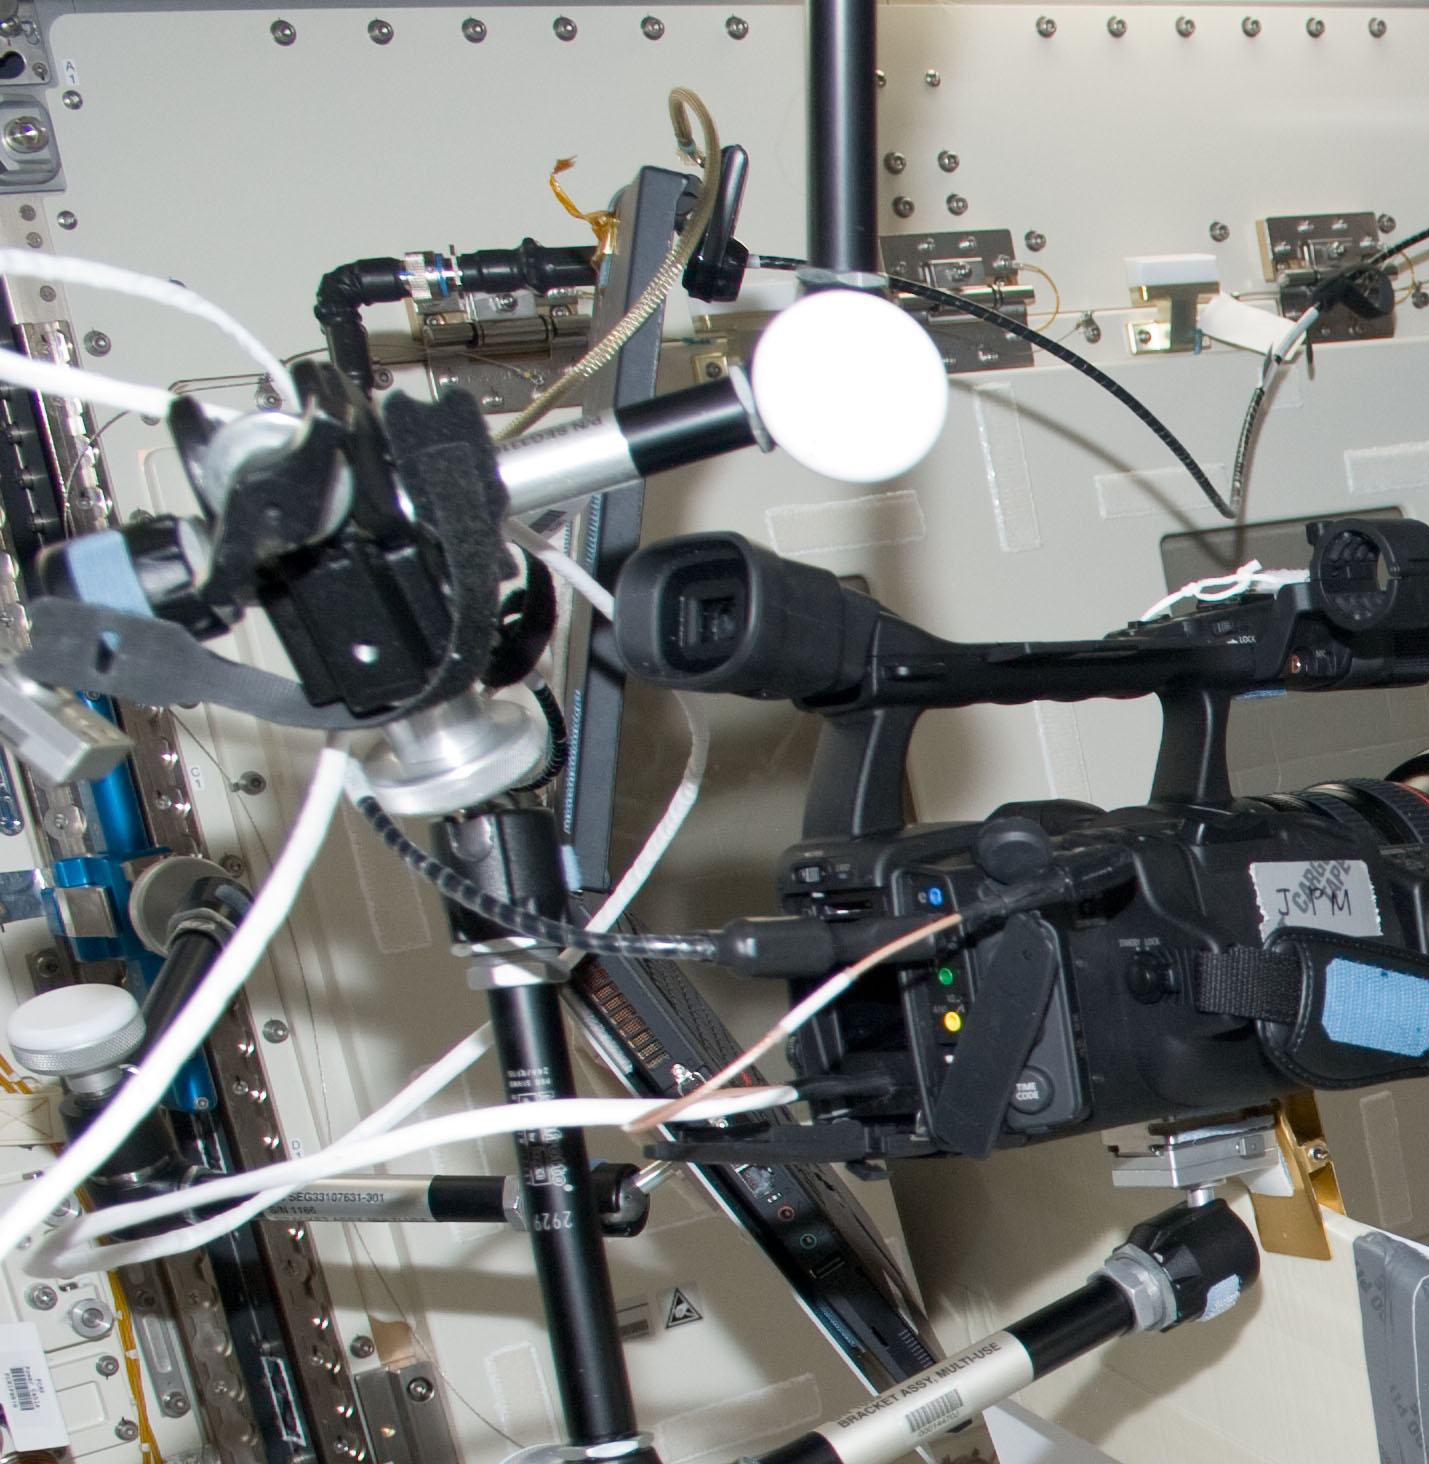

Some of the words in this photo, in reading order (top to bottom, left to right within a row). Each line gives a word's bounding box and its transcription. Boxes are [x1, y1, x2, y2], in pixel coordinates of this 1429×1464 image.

[1239, 636, 1256, 645] LOCK
[1016, 1082, 1037, 1091] TIME
[1016, 1091, 1039, 1101] CODE
[534, 1211, 573, 1231] 2929
[838, 1395, 899, 1428] BRACKET
[935, 1342, 1003, 1379] MULTI-USE
